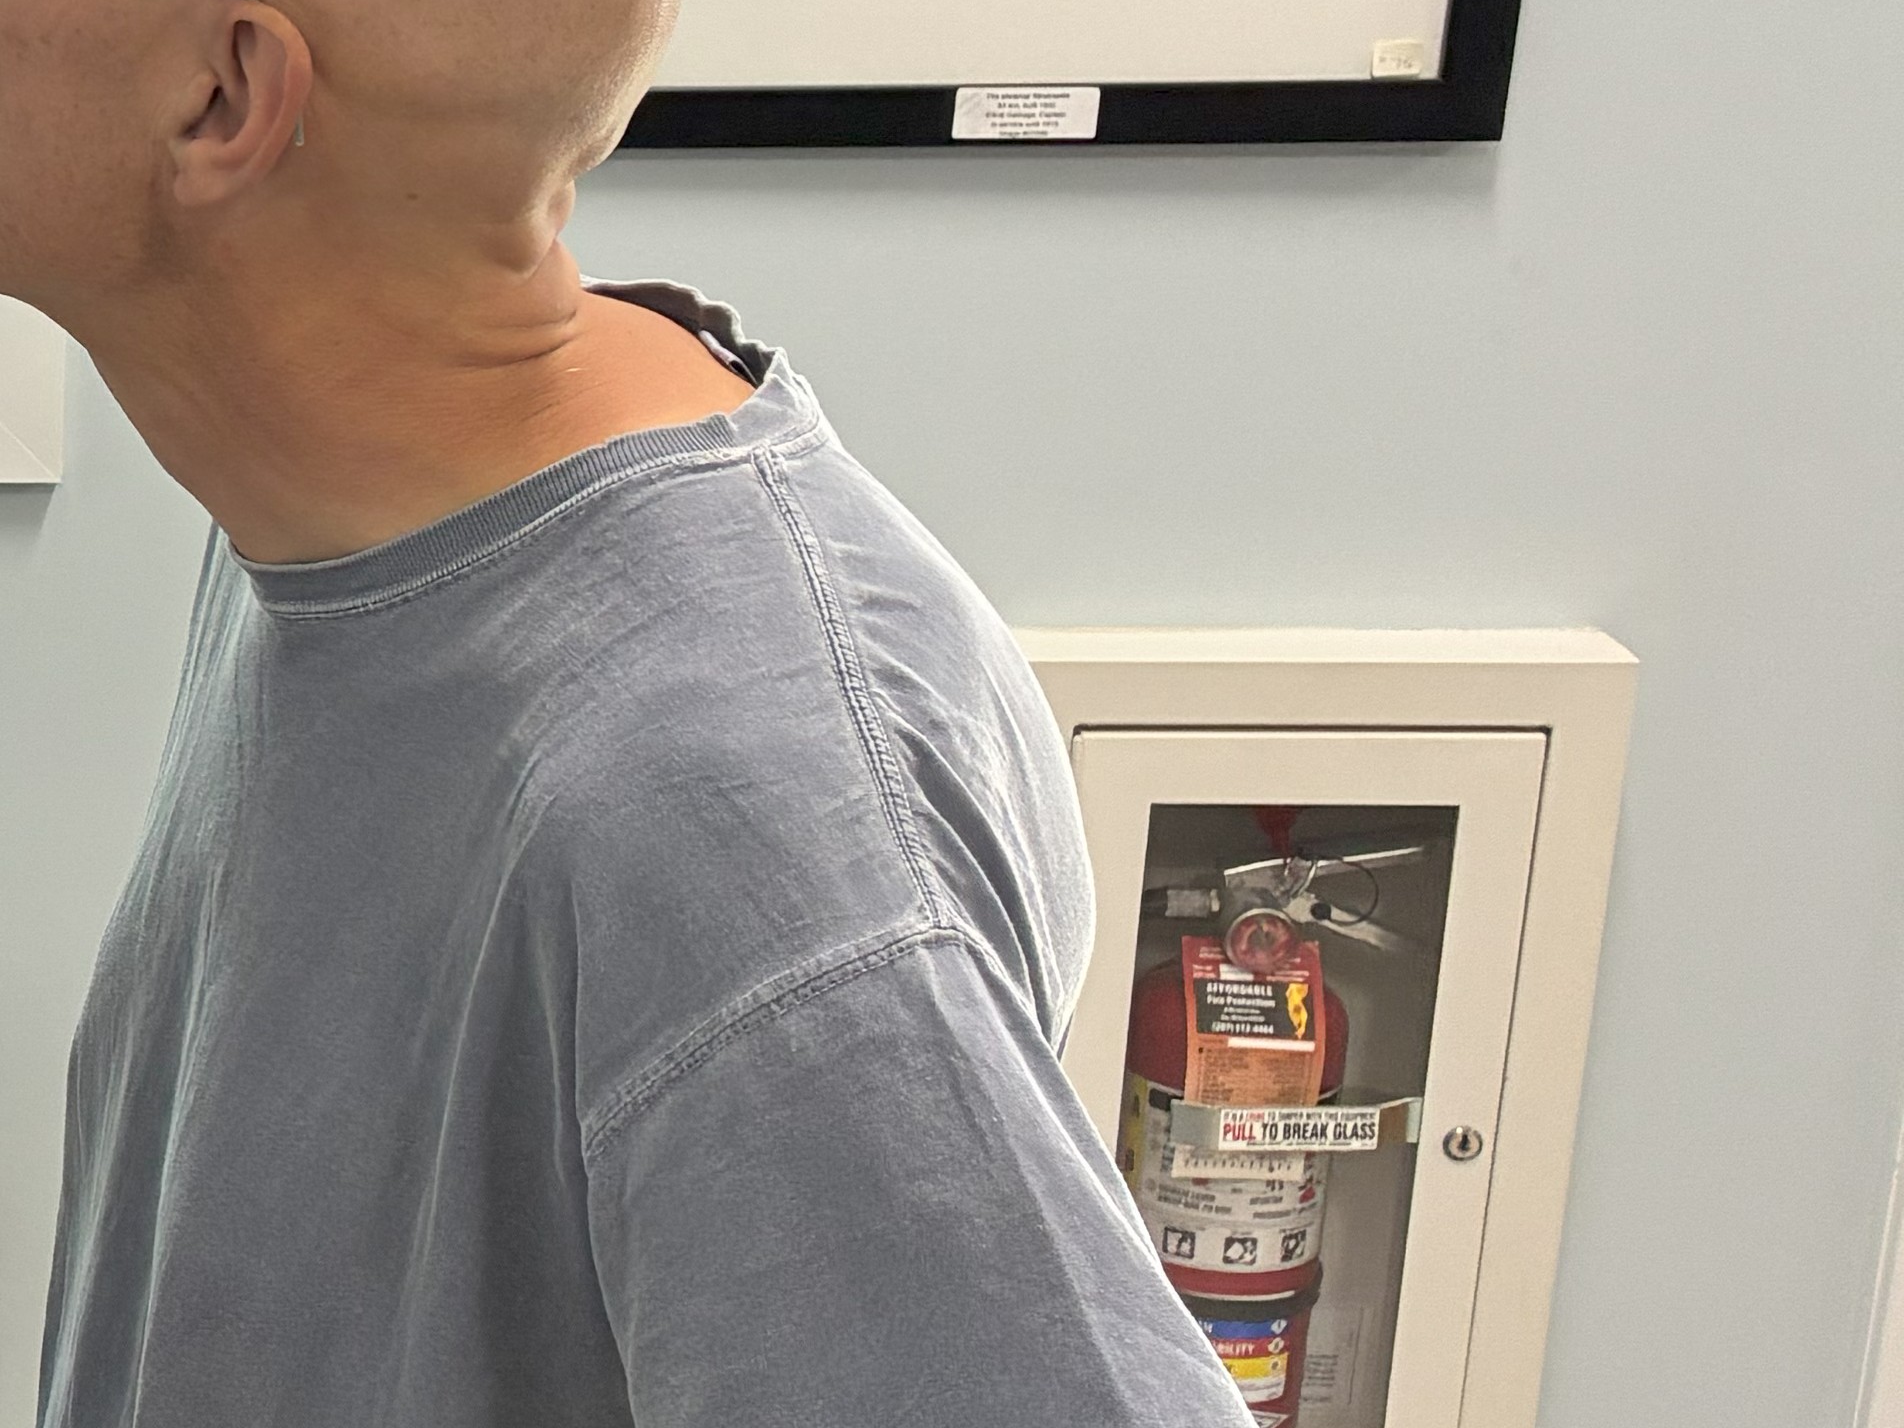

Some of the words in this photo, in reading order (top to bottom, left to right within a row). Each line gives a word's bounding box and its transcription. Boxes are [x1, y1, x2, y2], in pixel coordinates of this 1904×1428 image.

[1223, 1123, 1257, 1141] PULL
[1262, 1123, 1278, 1141] TO
[1283, 1123, 1328, 1141] BREAK
[1333, 1123, 1376, 1140] GLASS
